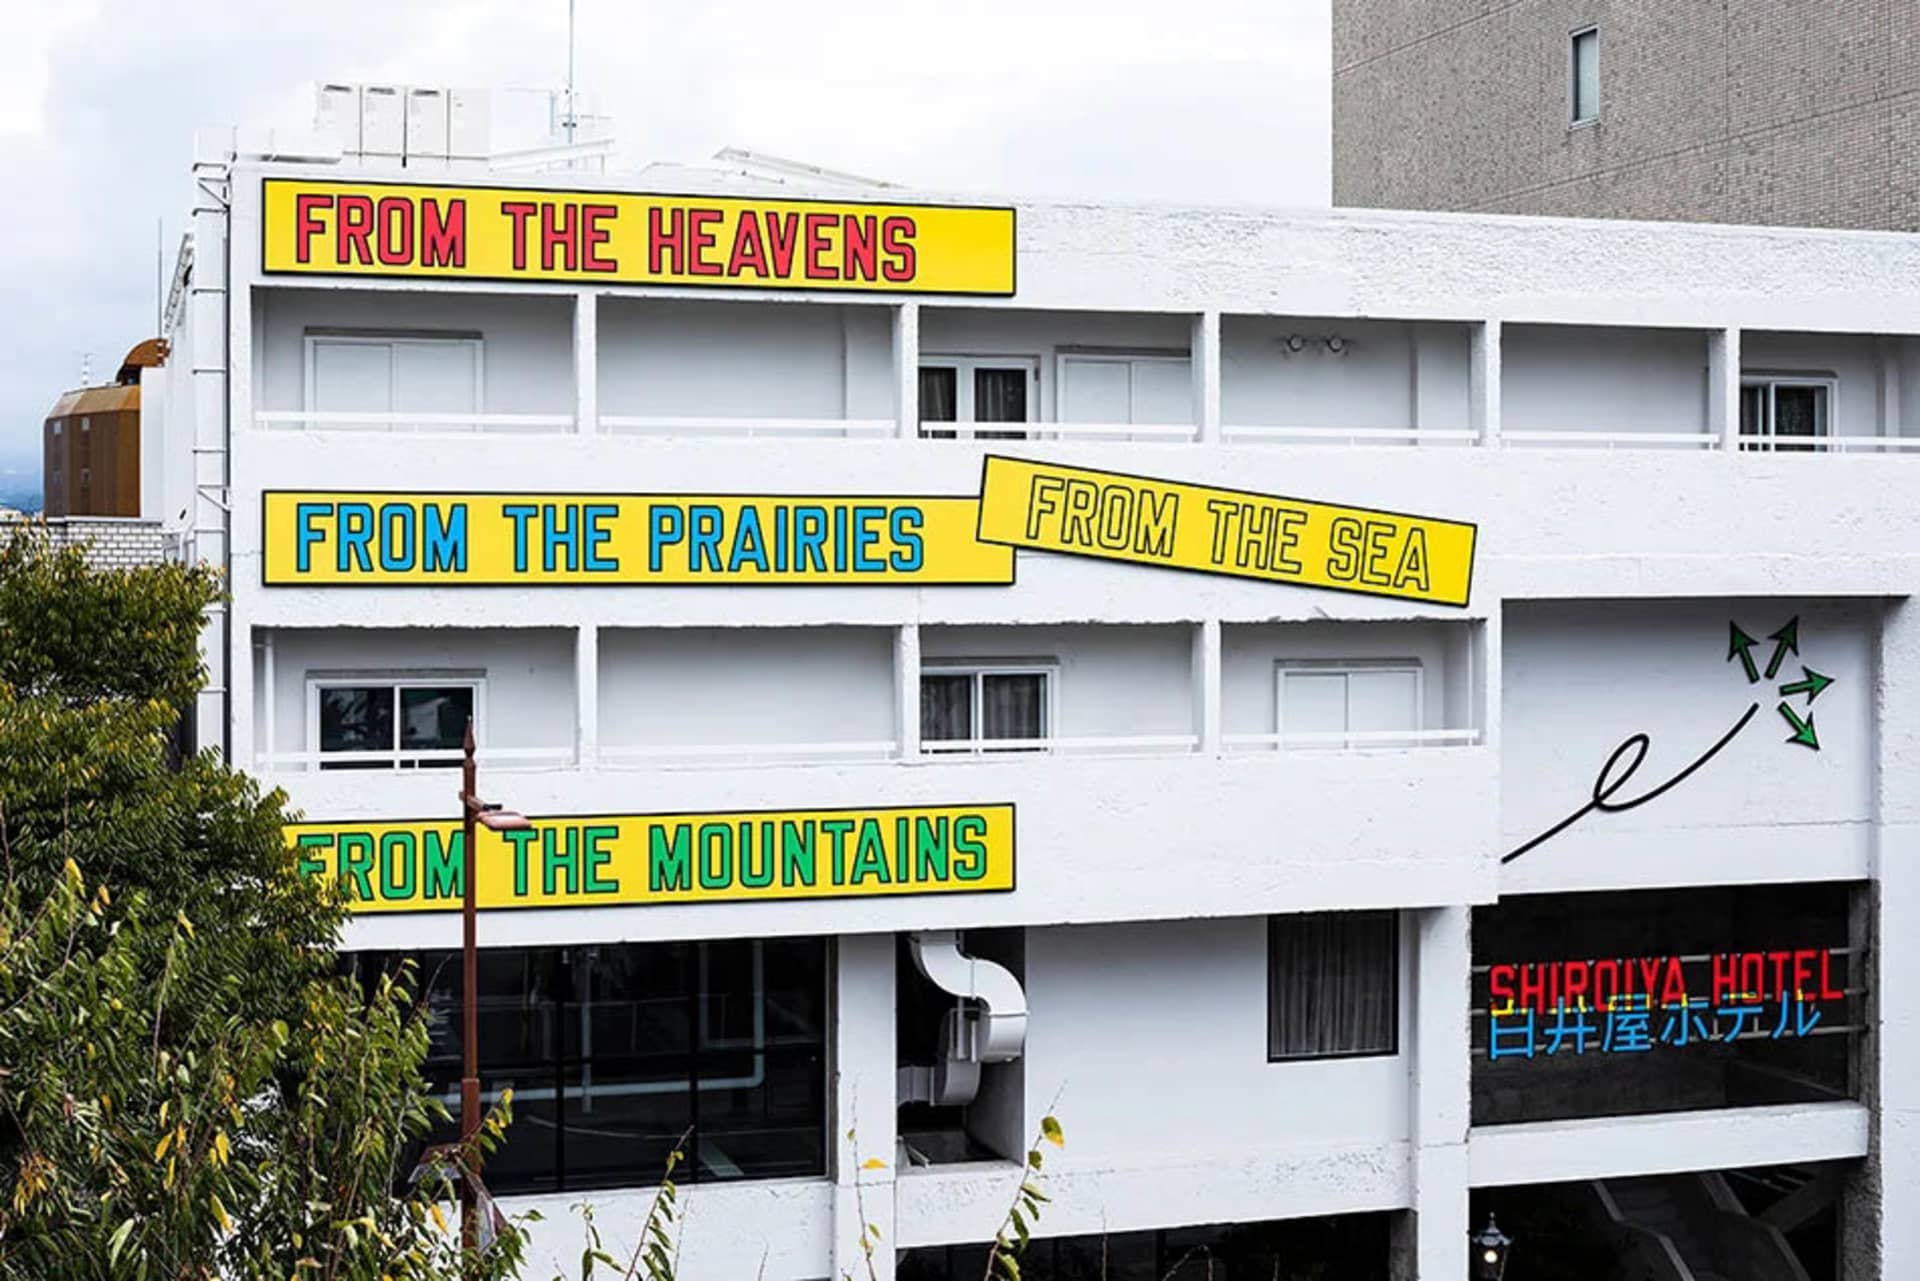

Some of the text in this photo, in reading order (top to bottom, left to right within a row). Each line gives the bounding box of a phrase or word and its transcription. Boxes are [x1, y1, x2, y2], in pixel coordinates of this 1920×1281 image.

[295, 193, 917, 283] FROM THE HEAVENS
[296, 502, 925, 573] FROM THE PRAIRIES
[1026, 475, 1430, 591] FROM THE SEA
[296, 815, 988, 902] FROM THE MOUNTAINS
[1490, 949, 1844, 1015] SHIROIYA HOTEL
[1490, 990, 1822, 1060] 白井屋ホテル
